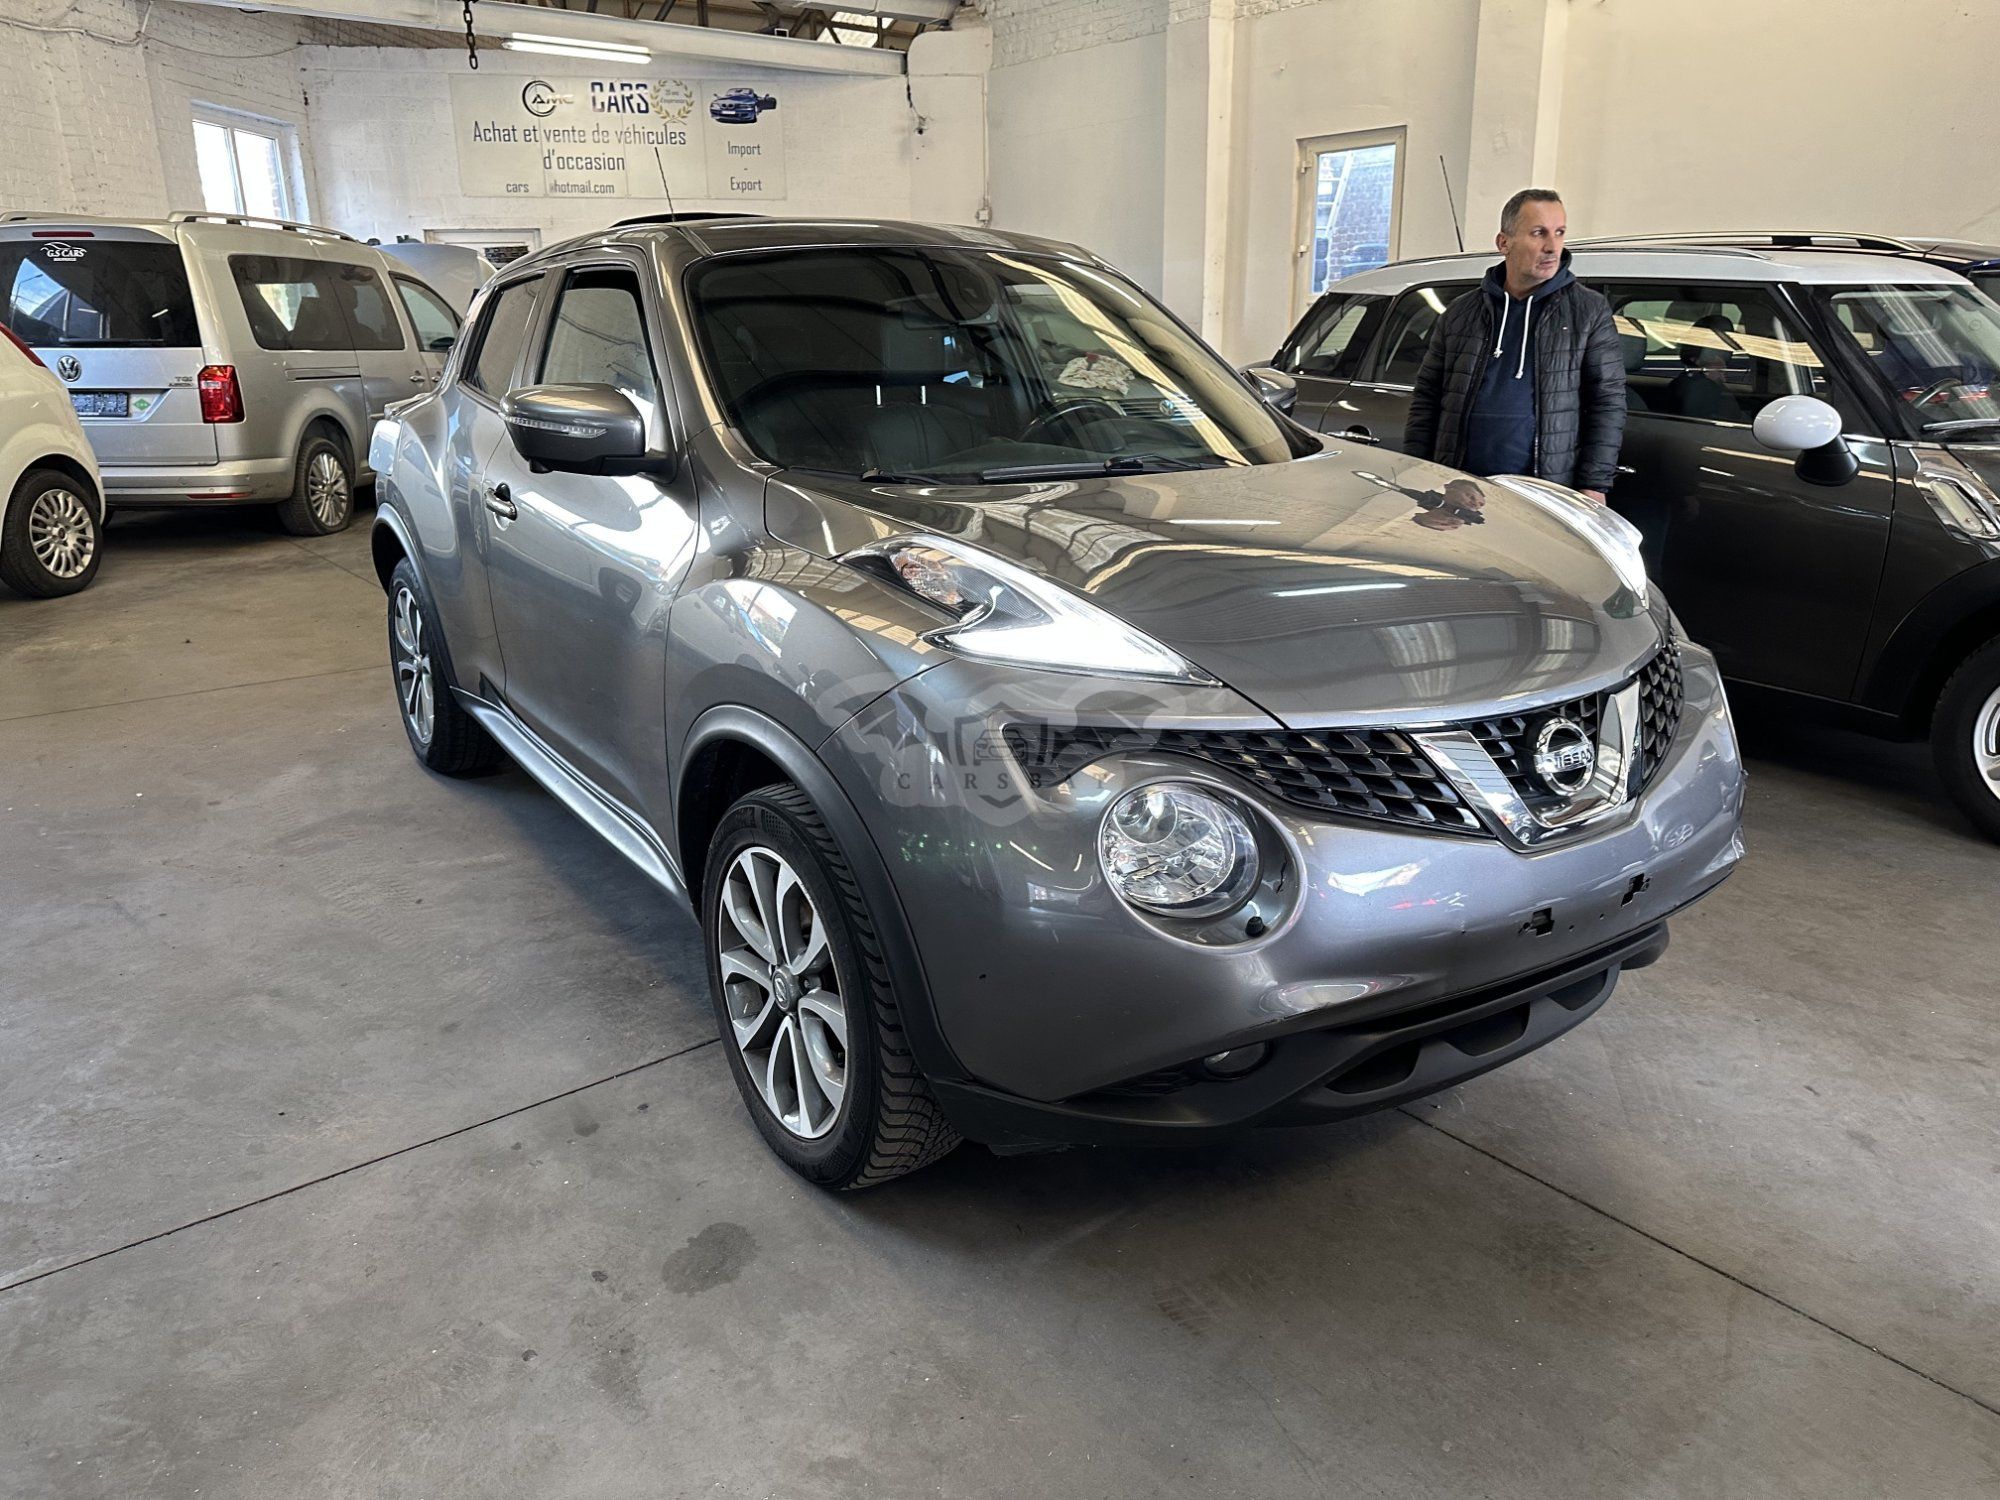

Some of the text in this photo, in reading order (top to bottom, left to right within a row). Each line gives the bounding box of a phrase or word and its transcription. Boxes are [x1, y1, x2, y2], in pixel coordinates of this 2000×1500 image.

[590, 81, 650, 114] CARS
[473, 120, 687, 145] Achat et vente de véhicules
[543, 148, 626, 171] d'occasion
[727, 140, 761, 158] Import
[730, 176, 762, 193] Export
